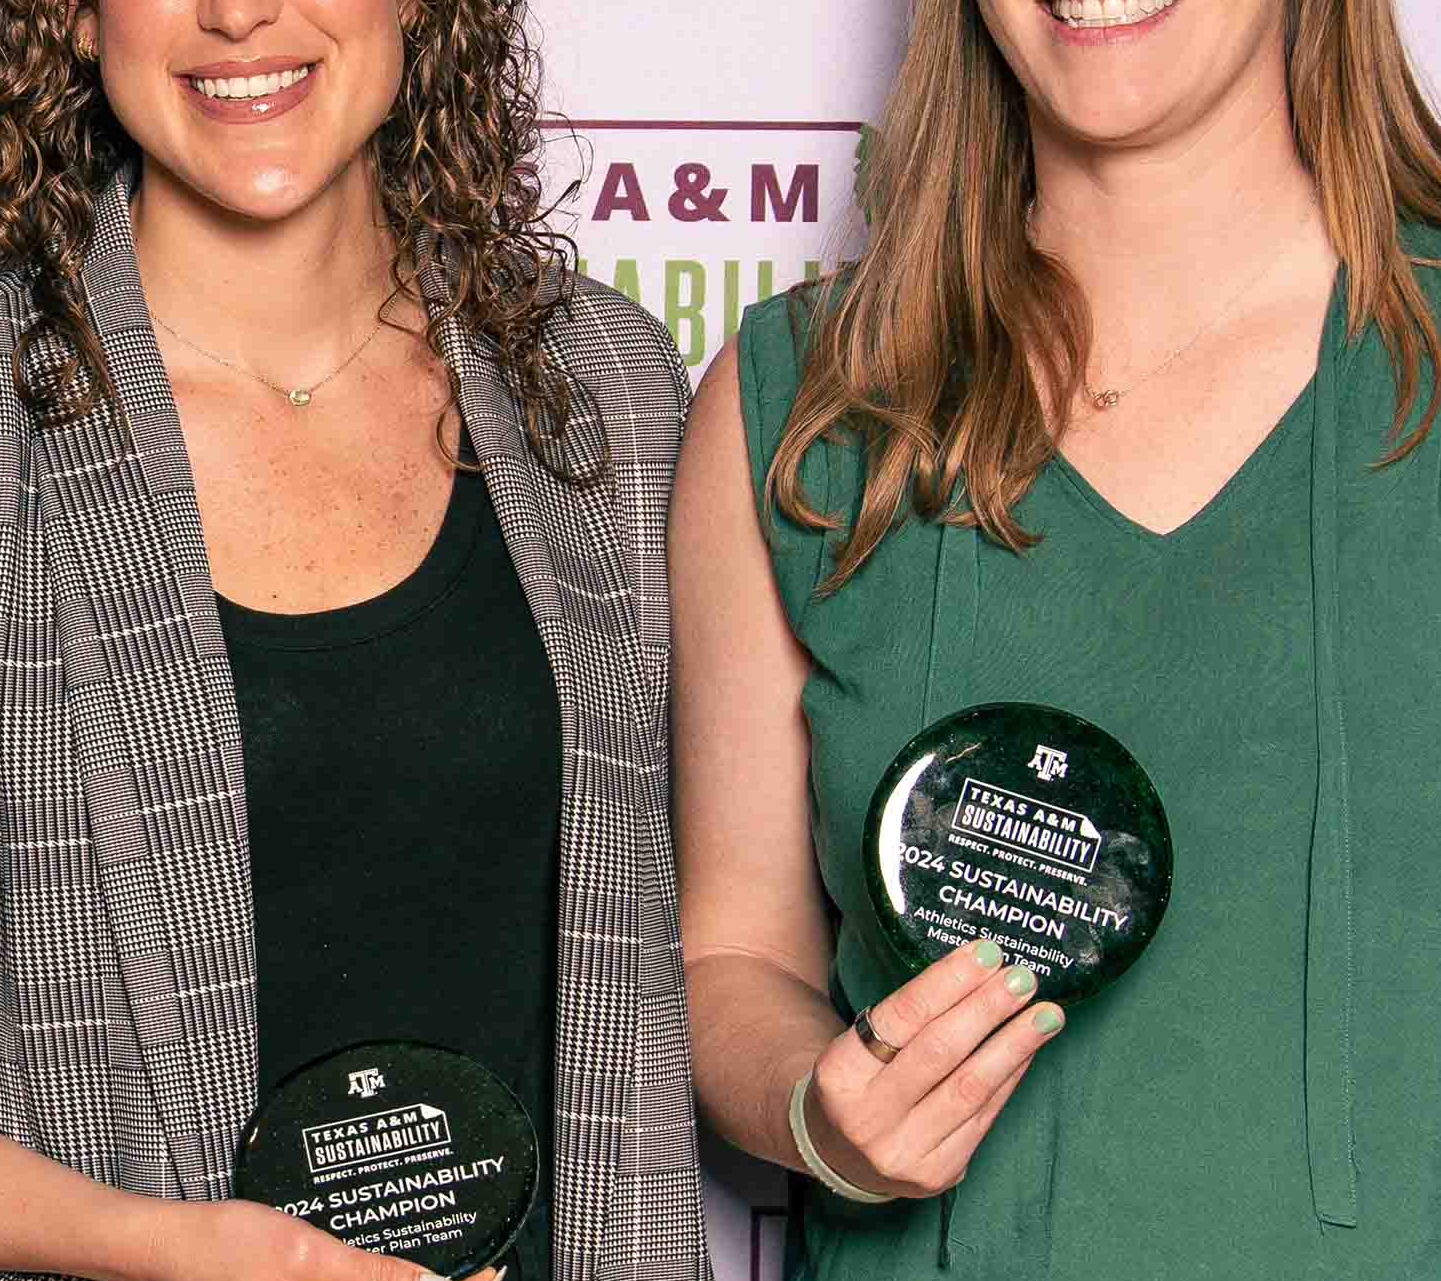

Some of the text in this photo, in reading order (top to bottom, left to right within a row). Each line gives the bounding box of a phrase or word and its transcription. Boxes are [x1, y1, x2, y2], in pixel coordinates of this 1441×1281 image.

[592, 163, 819, 222] A&M
[970, 787, 1075, 831] TEXAS A&M
[961, 804, 1090, 862] SUSTAINABILITY
[948, 834, 1087, 886] RESPECT. PROTECT. PRESERVE.
[939, 885, 1065, 938] CHAMPION
[949, 861, 1128, 931] SUSTAINABILITY
[913, 907, 976, 935] Athletics
[979, 926, 1074, 967] Sustainability
[1013, 953, 1051, 976] Team
[311, 1111, 417, 1143] TEXAS A&M
[315, 1120, 441, 1166] SUSTAINABILITY
[314, 1149, 453, 1184] RESPECT. PROTECT. PRESERVE.
[328, 1156, 504, 1208] SUSTAINABILITY
[330, 1191, 456, 1230] CHAMPION
[383, 1211, 477, 1239] Sustainability
[389, 1235, 420, 1251] Plan
[422, 1227, 463, 1243] Team
